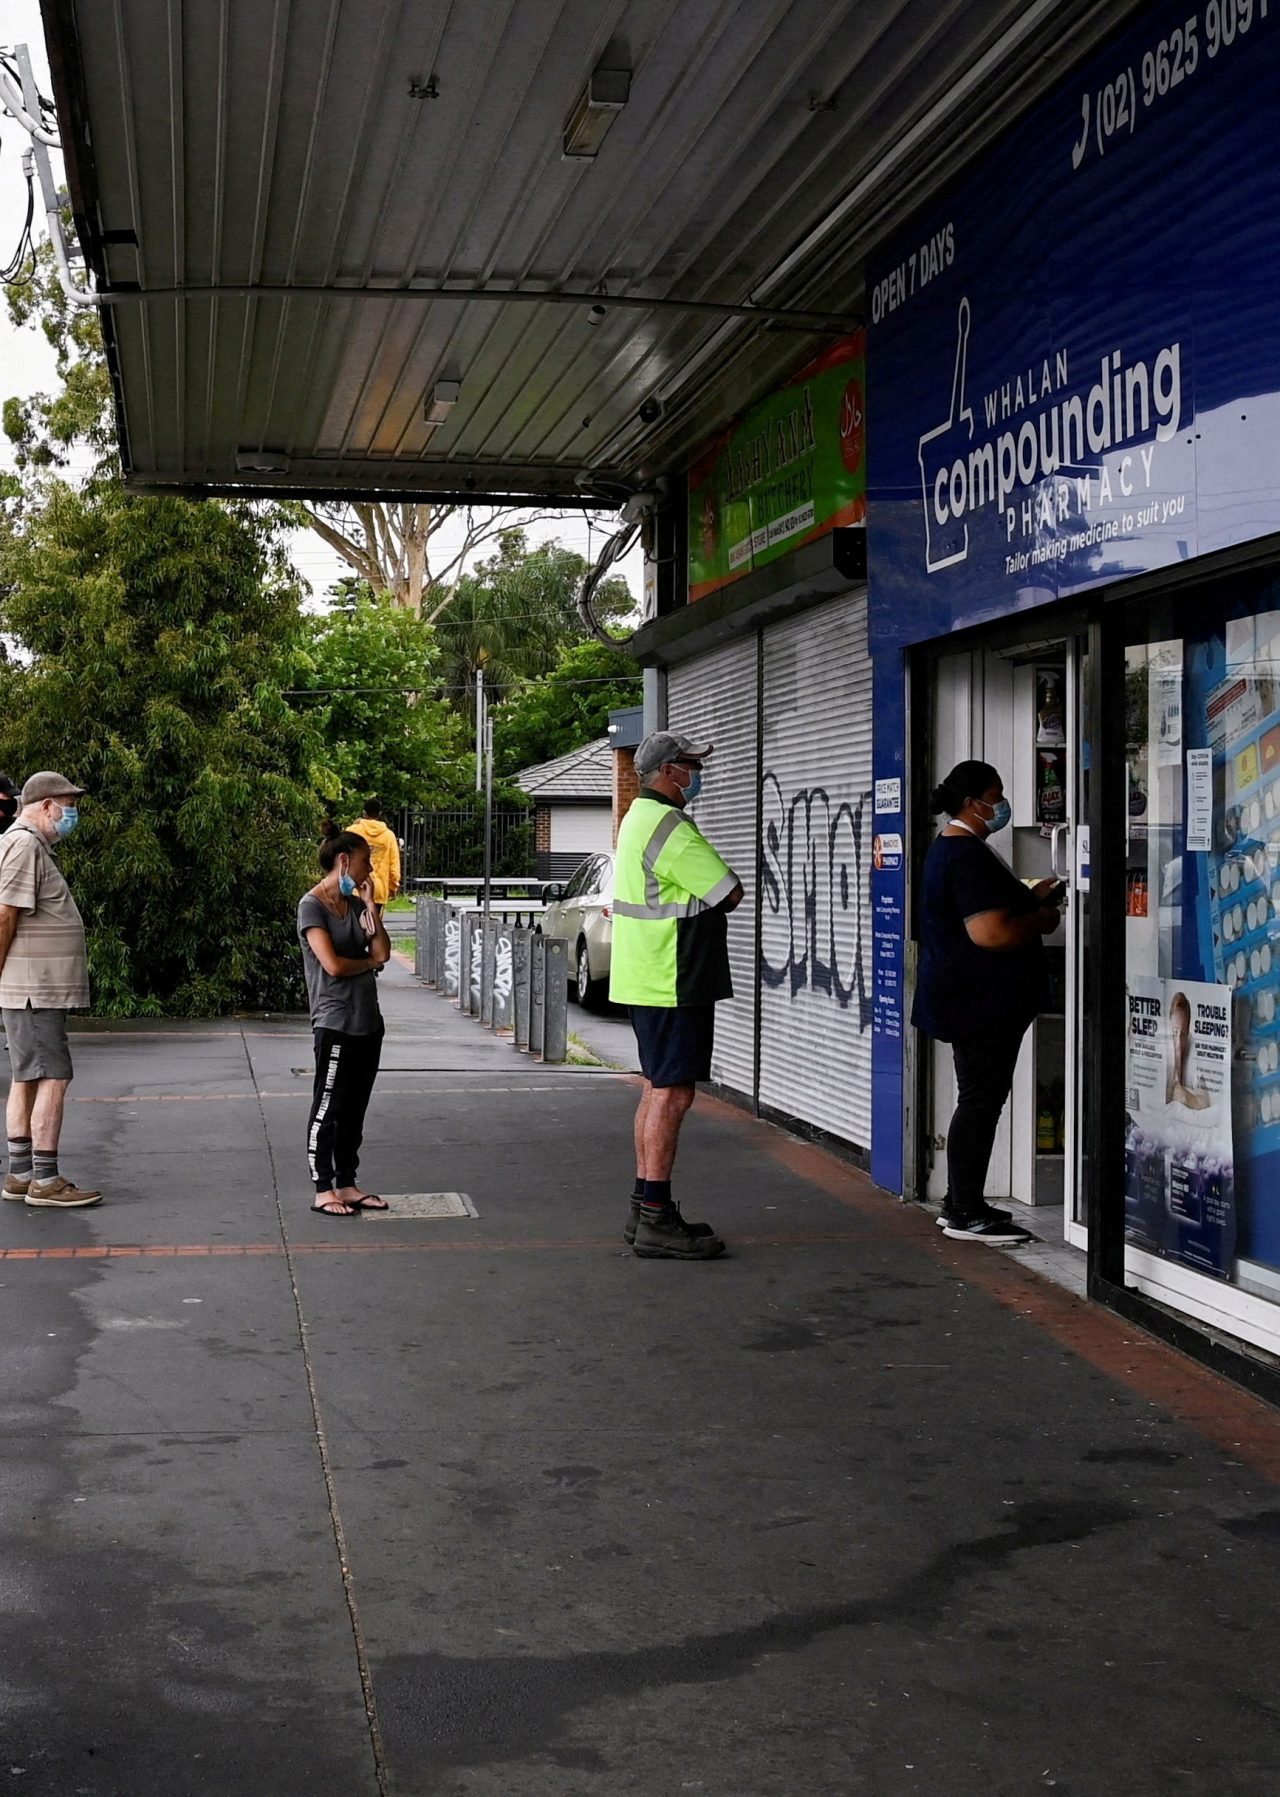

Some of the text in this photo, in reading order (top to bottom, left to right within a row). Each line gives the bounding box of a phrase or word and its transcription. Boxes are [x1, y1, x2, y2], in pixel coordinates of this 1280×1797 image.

[1097, 67, 1136, 155] (02)
[1142, 15, 1198, 106] 9625
[872, 222, 955, 324] OPEN 7 DAYS
[984, 349, 1068, 428] WHALAN
[934, 342, 1181, 525] compounding
[757, 456, 815, 522] BUTCHERY
[1006, 446, 1154, 542] PHARMACY
[1005, 496, 1185, 575] Tailor making medicine to suit you
[1129, 996, 1161, 1017] BETTER
[1132, 1017, 1158, 1038] SLEEP
[1194, 1020, 1229, 1038] SLEEPING?
[1197, 1004, 1227, 1021] TROUBLE
